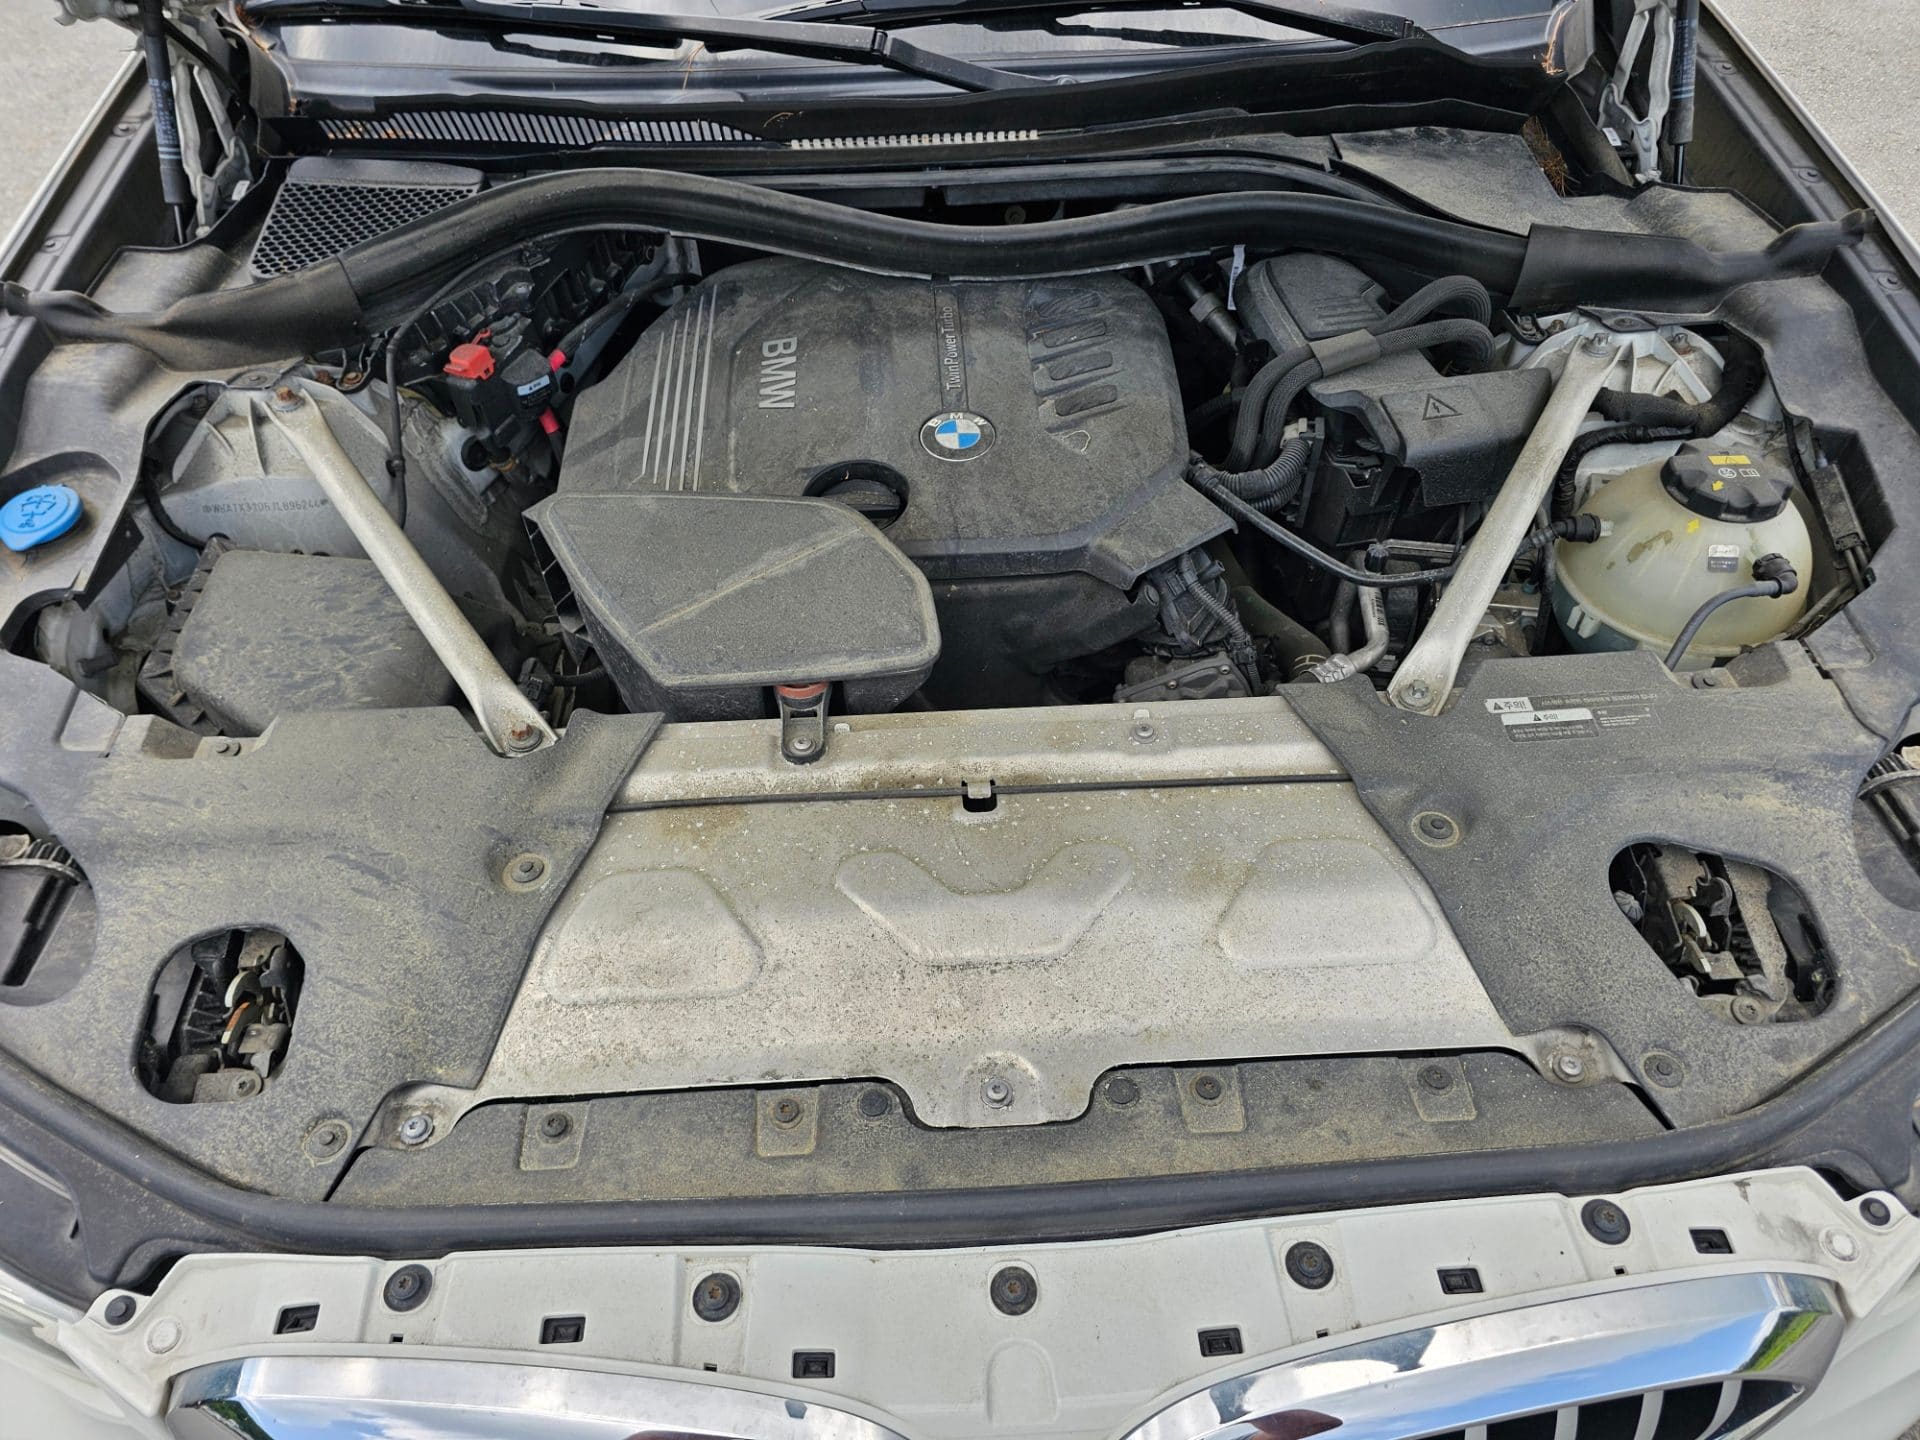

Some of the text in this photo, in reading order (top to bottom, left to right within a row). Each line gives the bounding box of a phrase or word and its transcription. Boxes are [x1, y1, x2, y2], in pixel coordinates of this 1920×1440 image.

[940, 306, 961, 391] TwinPower Turbo
[759, 336, 798, 408] BMW
[927, 412, 988, 428] BMW
[1504, 700, 1527, 711] 주의!
